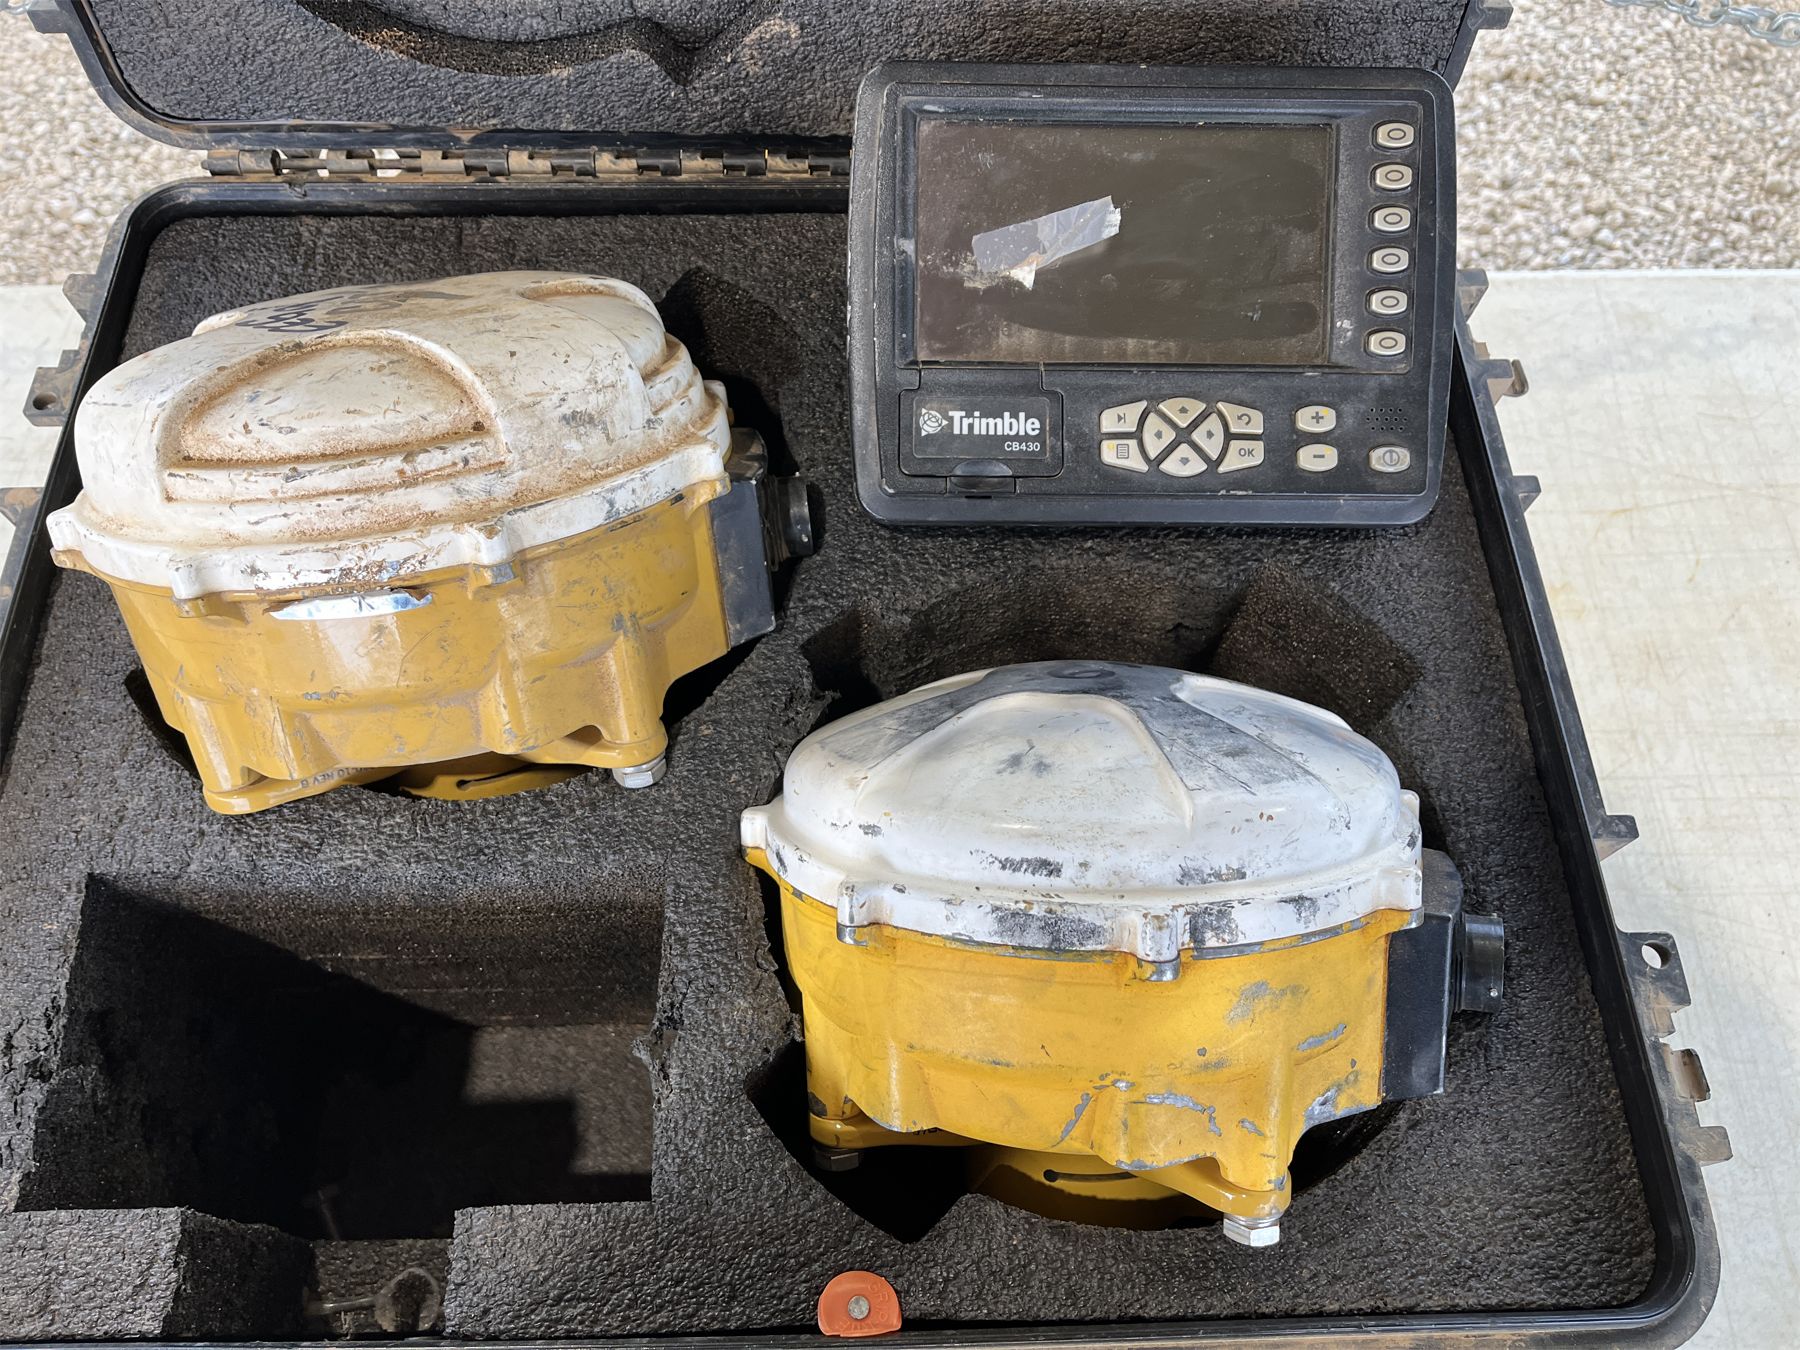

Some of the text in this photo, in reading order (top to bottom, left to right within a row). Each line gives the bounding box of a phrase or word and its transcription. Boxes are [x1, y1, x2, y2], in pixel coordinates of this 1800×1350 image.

[948, 410, 1041, 436] Trimble
[1004, 441, 1041, 452] CB430
[1238, 447, 1256, 458] OK
